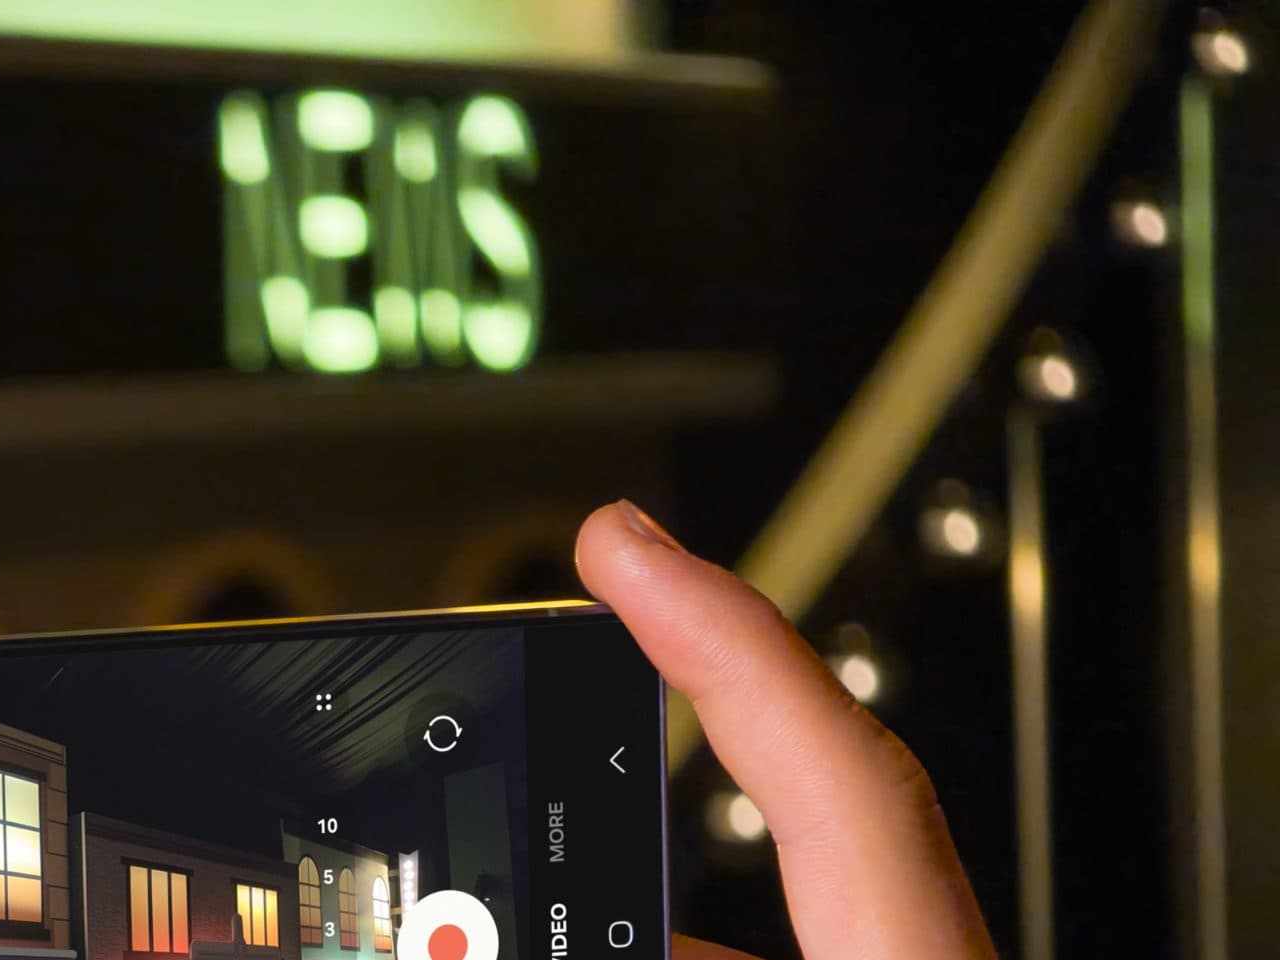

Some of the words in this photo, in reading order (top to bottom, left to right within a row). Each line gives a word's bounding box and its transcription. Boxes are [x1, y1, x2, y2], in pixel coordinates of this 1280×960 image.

[317, 818, 338, 834] 10
[549, 802, 565, 863] MORE
[323, 869, 334, 884] 5
[324, 922, 335, 937] 3
